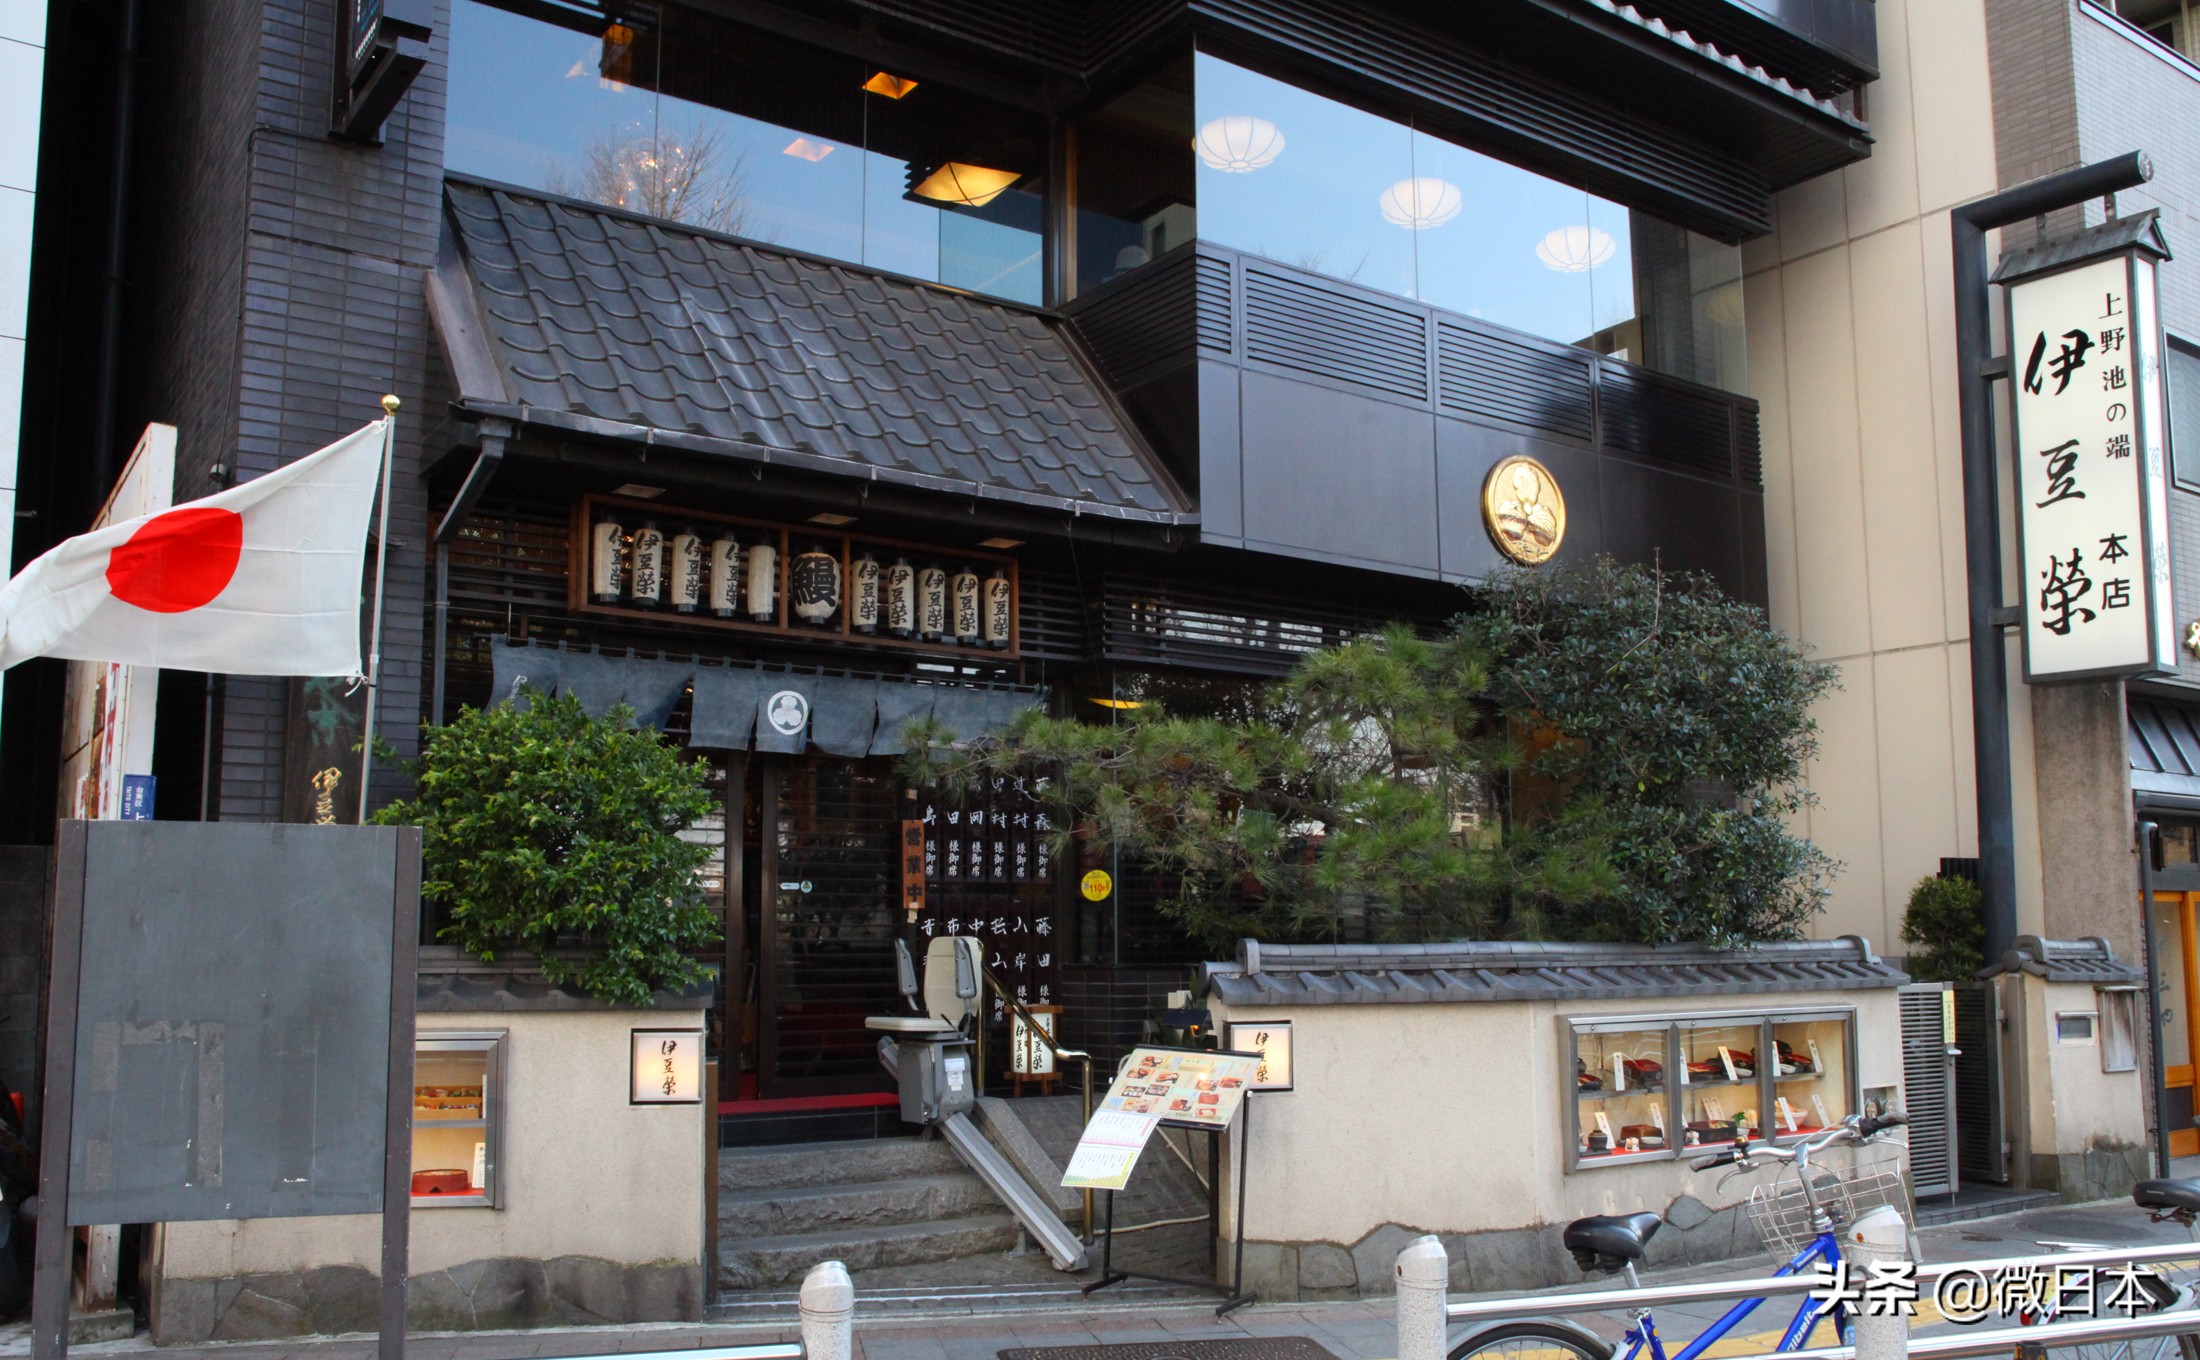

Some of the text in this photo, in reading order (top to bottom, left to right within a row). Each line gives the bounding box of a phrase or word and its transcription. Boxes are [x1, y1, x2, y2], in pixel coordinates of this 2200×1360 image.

[2098, 292, 2131, 460] 上野池の端
[2023, 328, 2096, 636] 伊豆榮
[791, 555, 837, 608] 鰻
[2099, 532, 2130, 611] 本店
